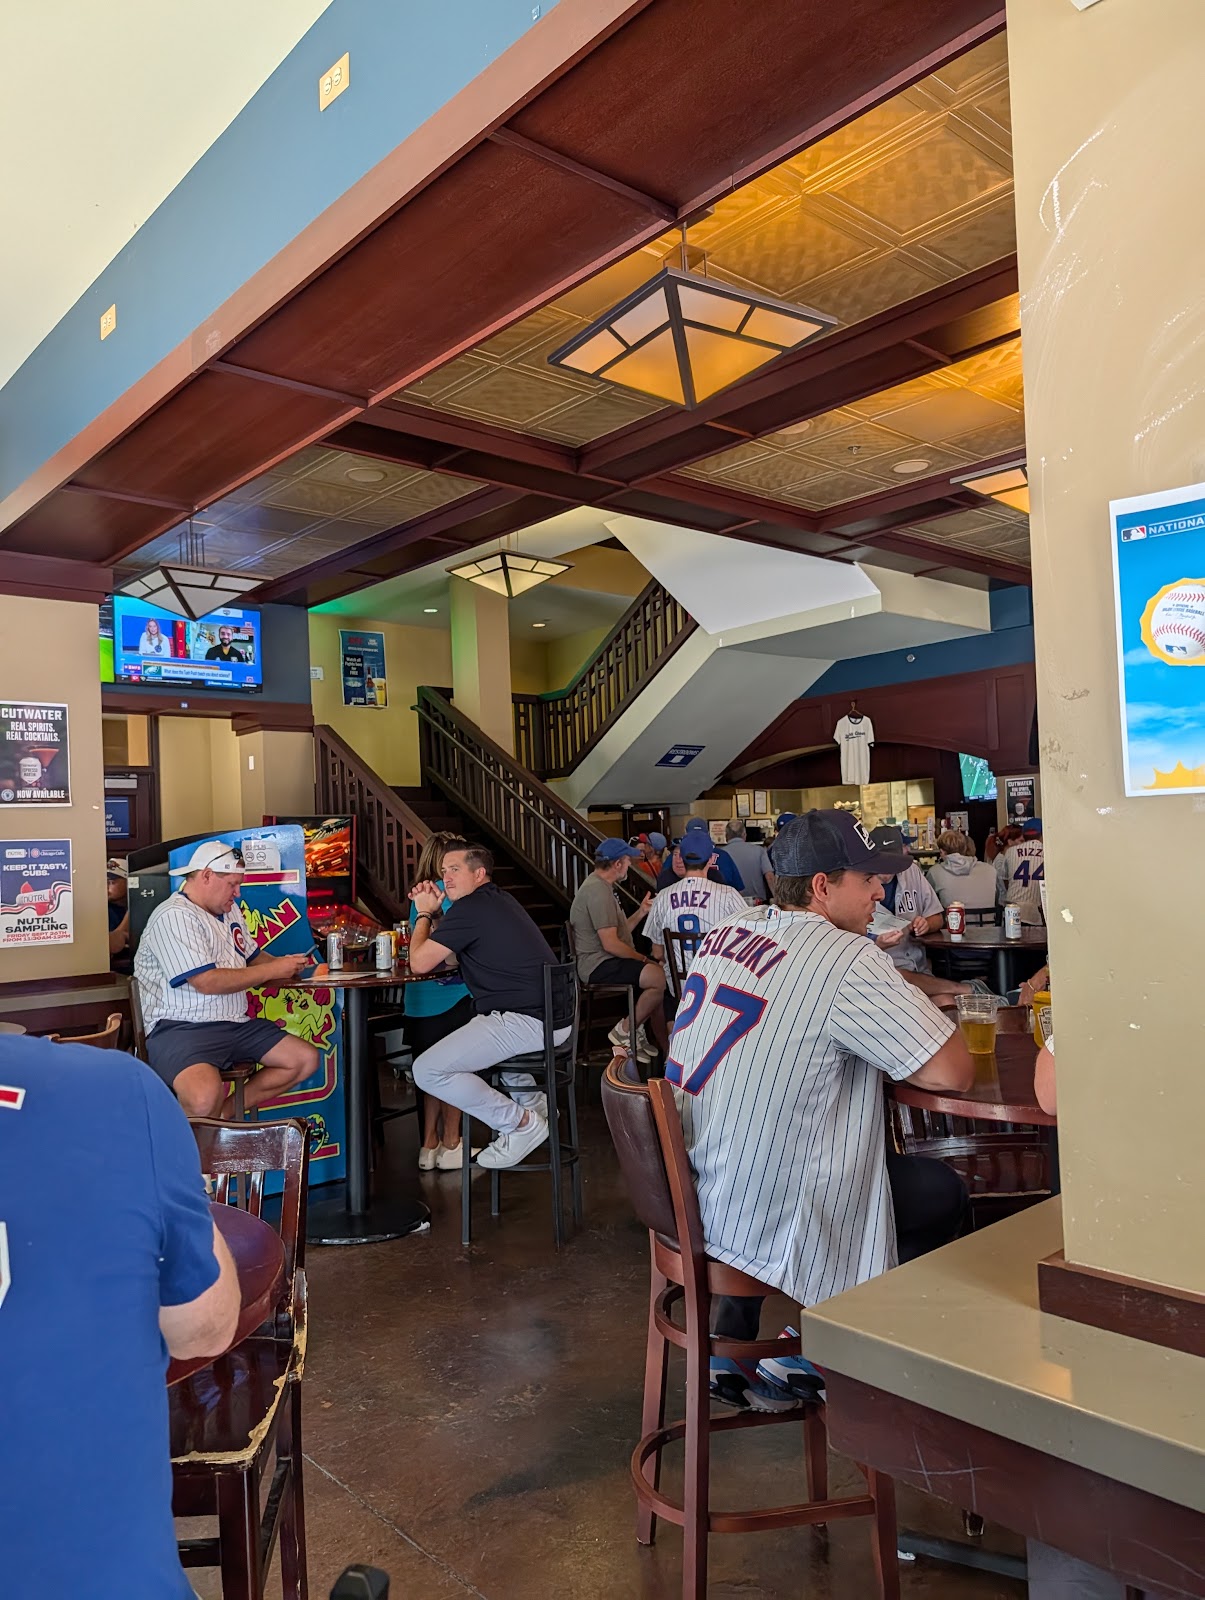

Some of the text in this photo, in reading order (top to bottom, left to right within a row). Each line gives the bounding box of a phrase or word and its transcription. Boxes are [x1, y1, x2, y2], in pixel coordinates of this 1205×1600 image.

[1149, 517, 1205, 535] NATIONA
[2, 708, 62, 720] CUTWATER
[11, 721, 55, 732] REAL SPIRITS.
[6, 731, 60, 742] REAL COCKTAILS.
[17, 790, 65, 799] NOW AVAILABLE
[1017, 847, 1044, 858] RIZZ
[670, 890, 711, 910] BAEZ
[17, 917, 57, 925] NUTRL
[5, 923, 68, 933] SAMPLING
[699, 925, 788, 980] SUZUKI
[664, 971, 769, 1097] 27
